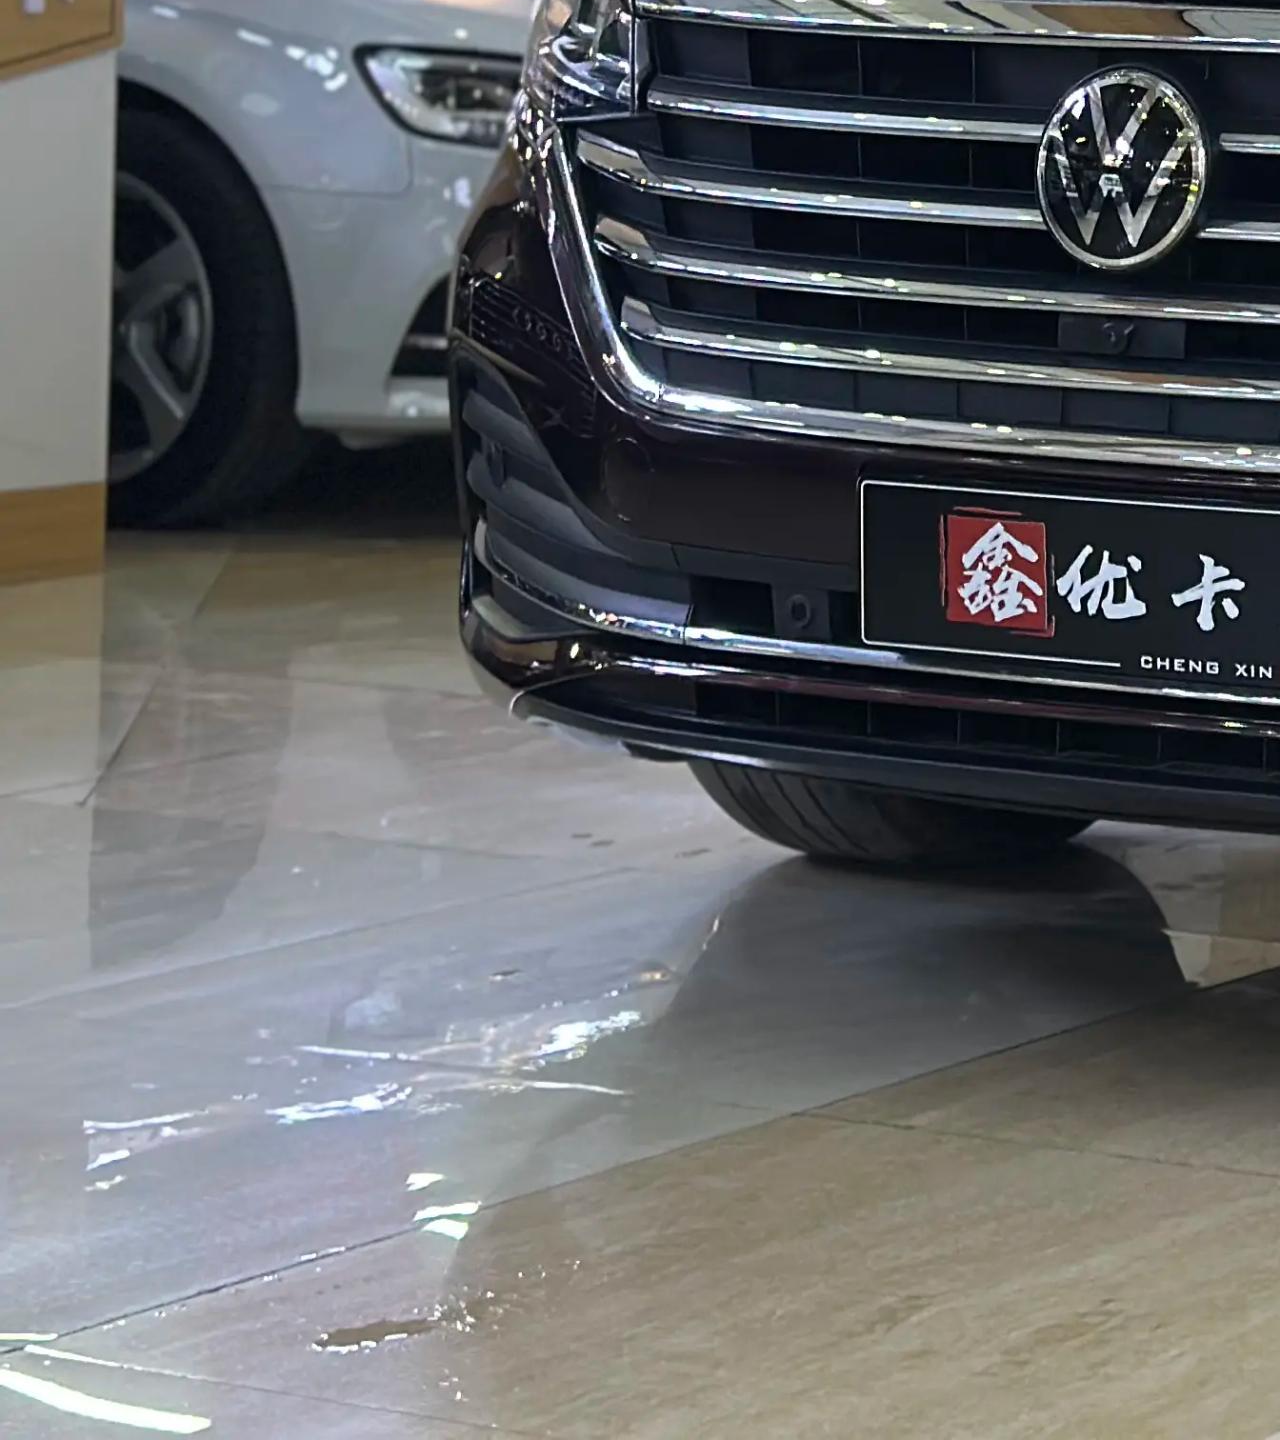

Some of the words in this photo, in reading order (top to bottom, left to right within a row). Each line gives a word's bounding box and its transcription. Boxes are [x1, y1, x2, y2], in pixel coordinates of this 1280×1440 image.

[958, 522, 1246, 632] 鑫优卡
[1140, 655, 1220, 675] CHENG
[1234, 663, 1273, 679] XIN
